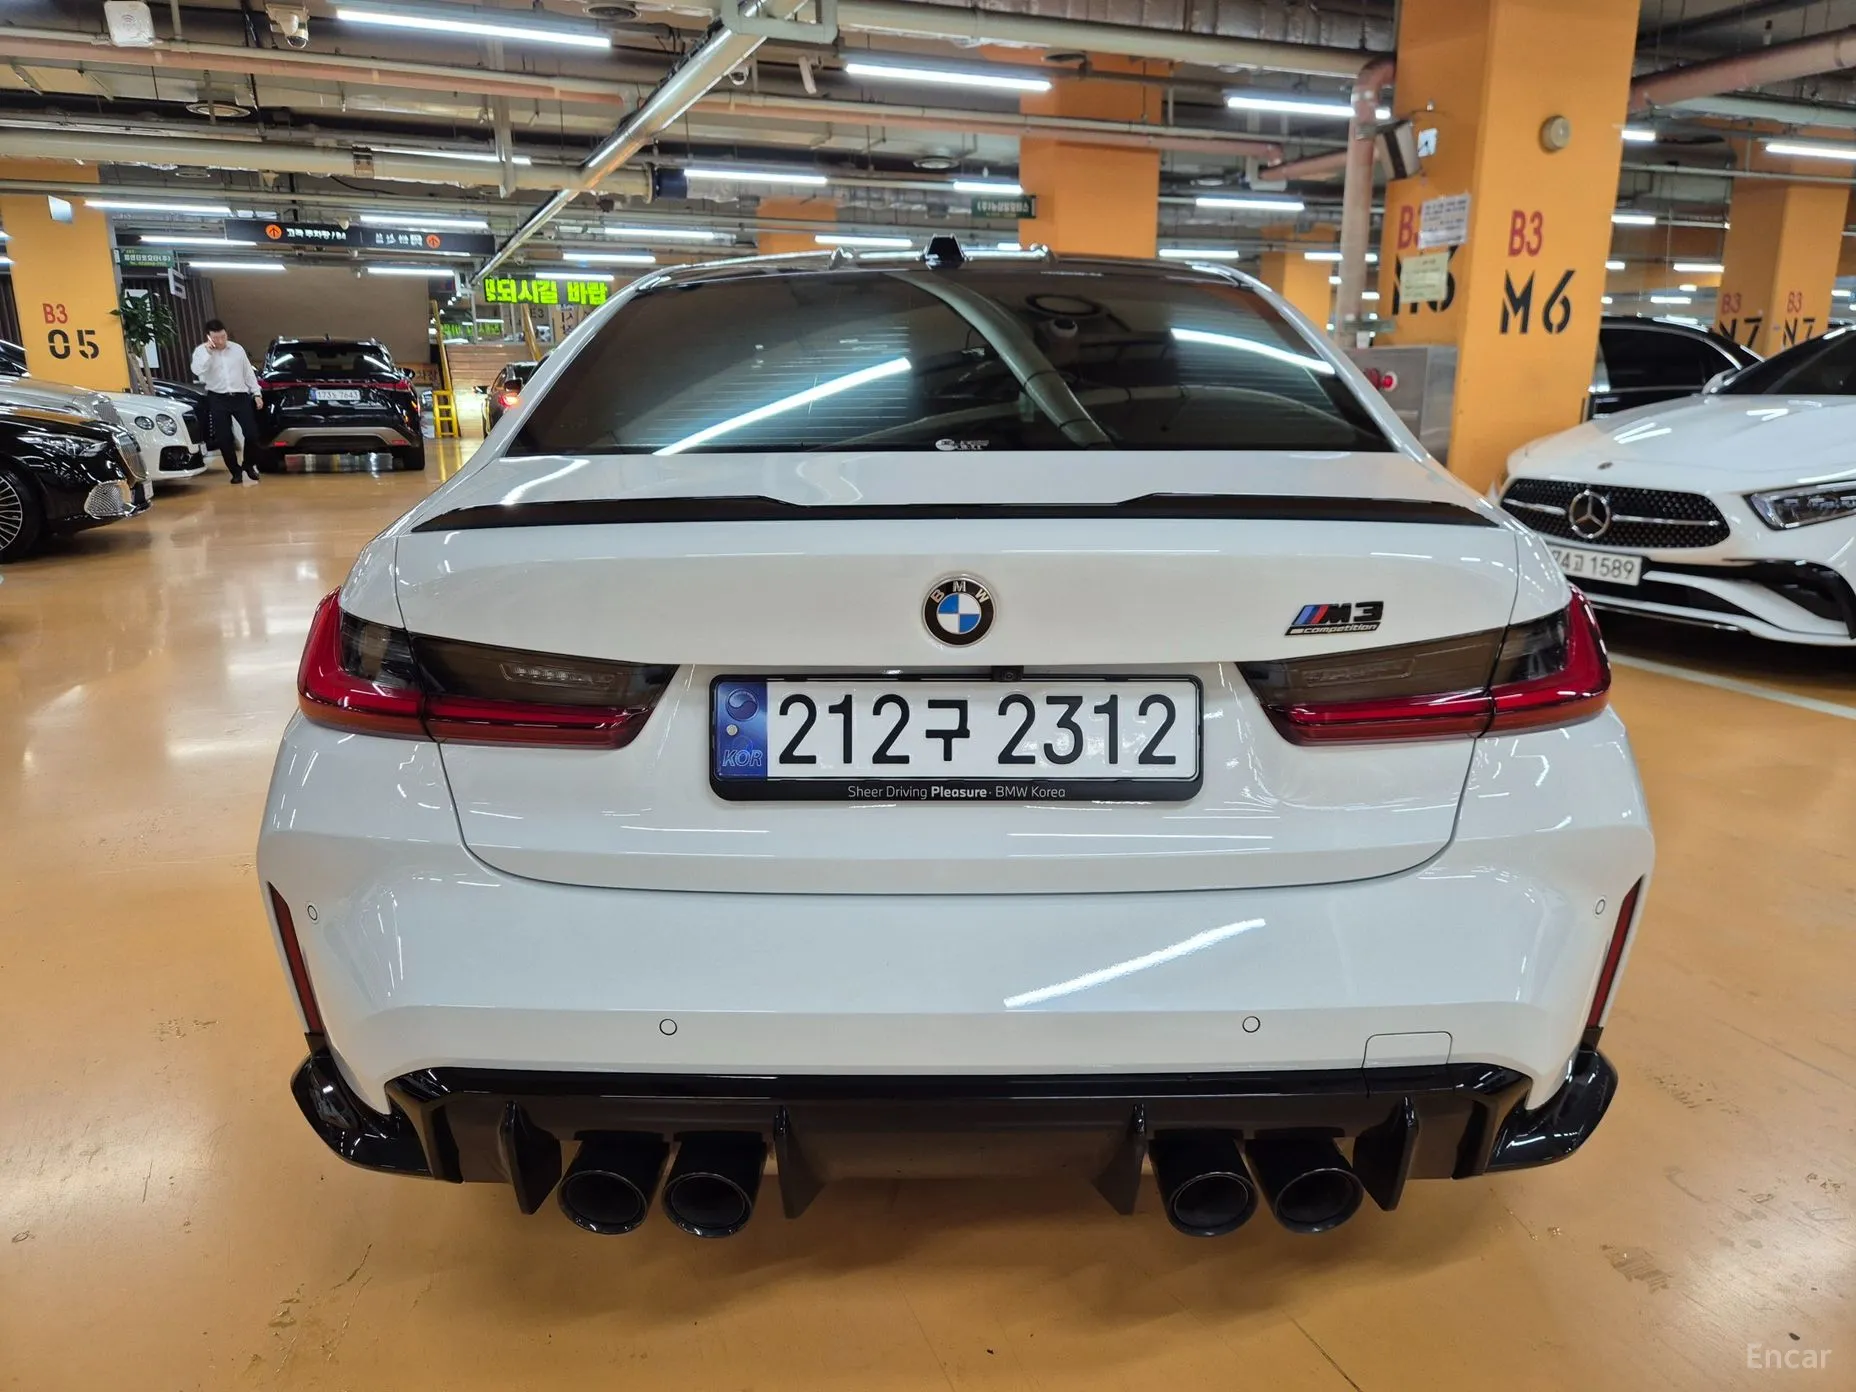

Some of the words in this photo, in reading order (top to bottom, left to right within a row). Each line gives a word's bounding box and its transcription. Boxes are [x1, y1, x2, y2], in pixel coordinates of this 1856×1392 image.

[1398, 205, 1420, 250] B
[1508, 209, 1543, 257] B3
[42, 303, 69, 324] B3
[1500, 269, 1576, 335] M6
[1721, 291, 1742, 314] B3
[1786, 290, 1803, 314] B3
[1590, 556, 1635, 580] 1589
[930, 580, 990, 603] BMW
[1303, 623, 1378, 634] competition
[778, 693, 971, 764] 212구
[998, 693, 1177, 764] 2312
[722, 749, 764, 767] KOR
[848, 785, 883, 798] Sheer
[886, 785, 927, 800] Driving
[995, 785, 1028, 798] BMW
[1031, 785, 1066, 798] Korea
